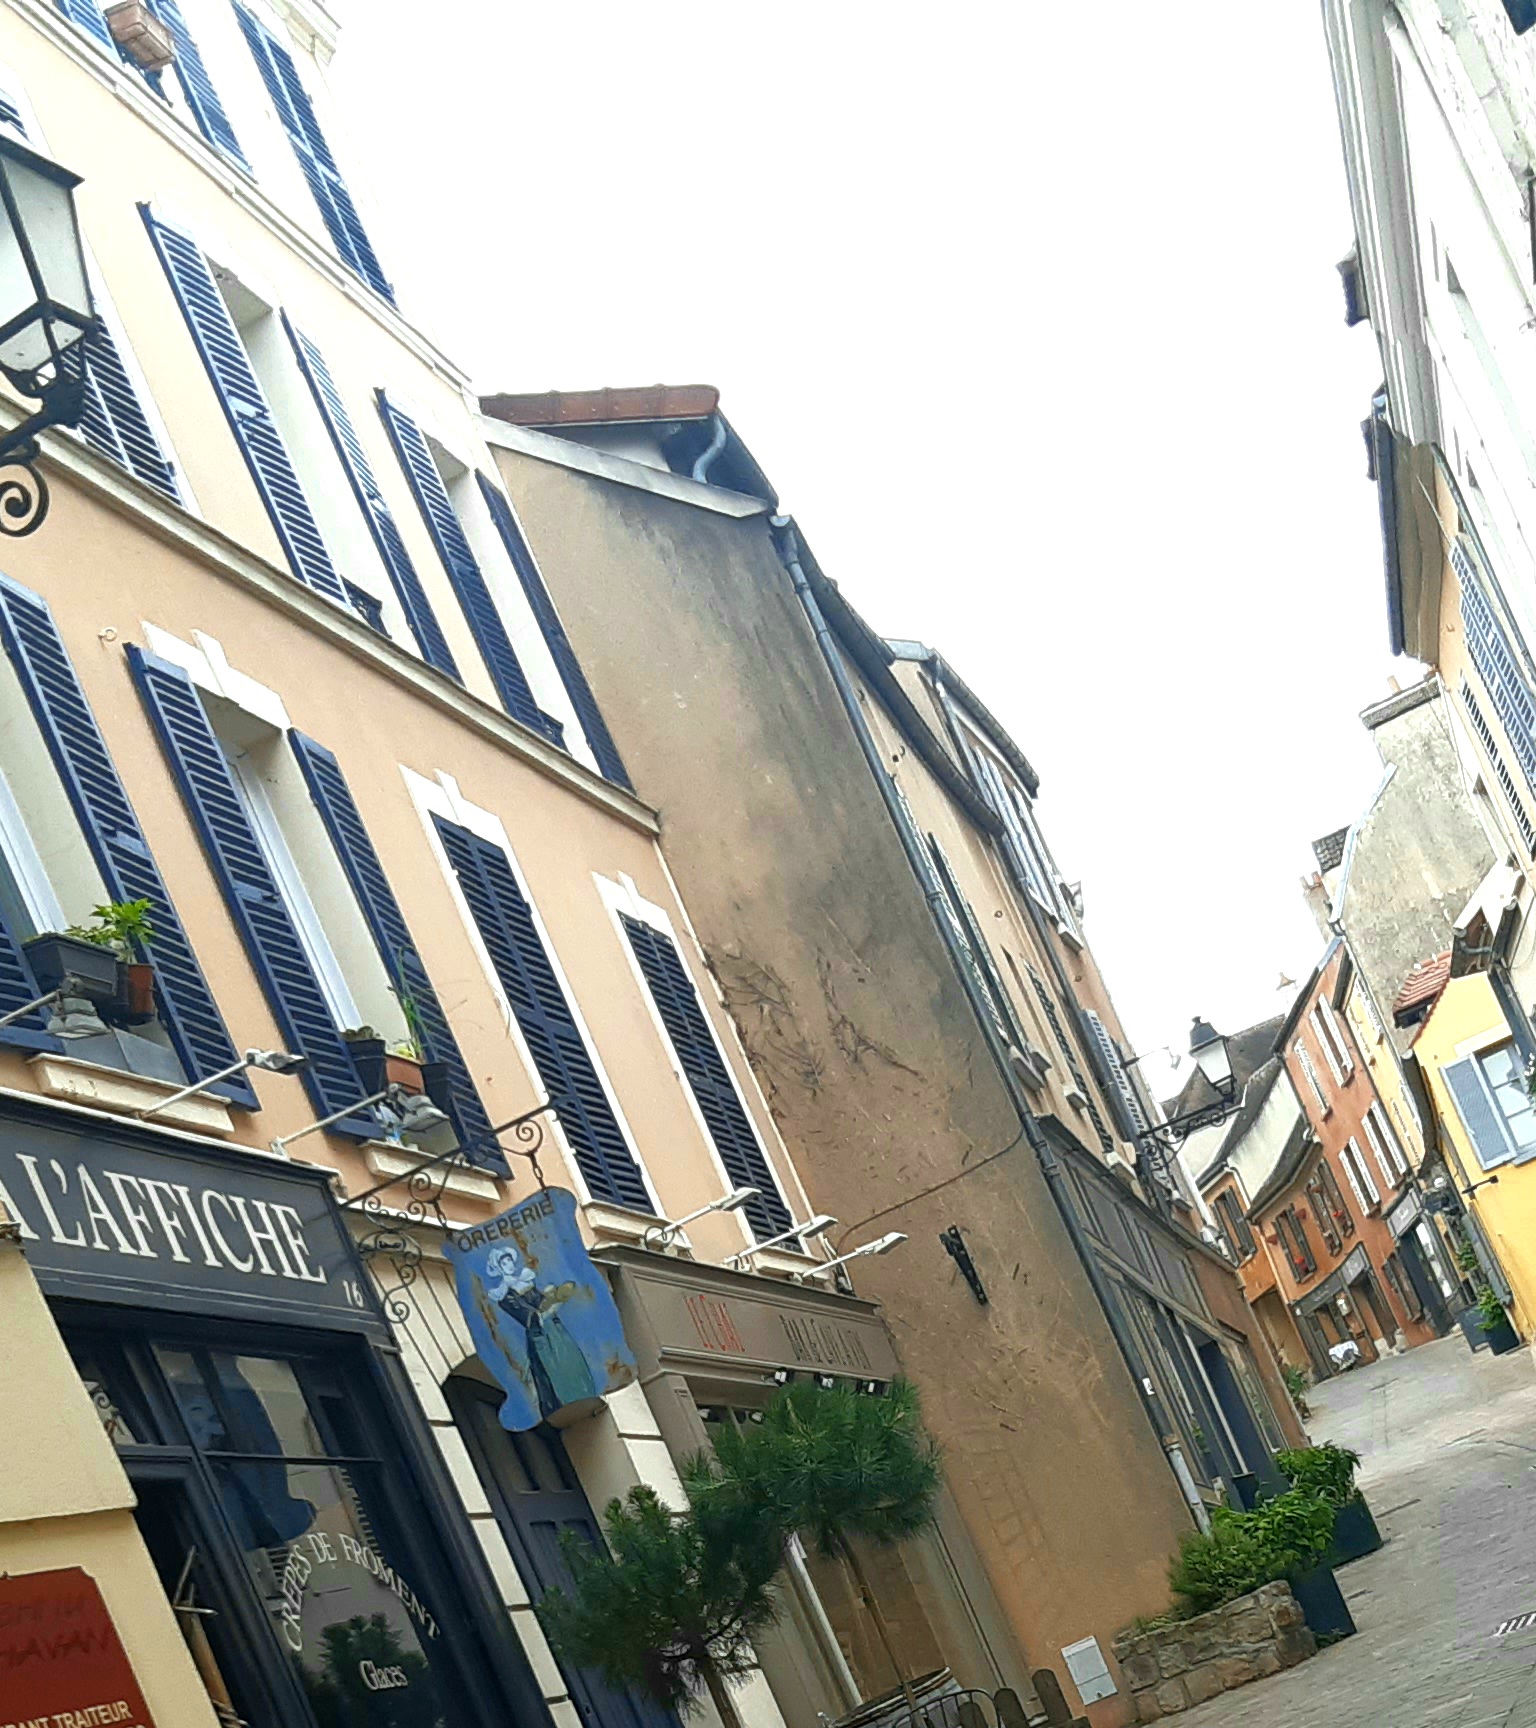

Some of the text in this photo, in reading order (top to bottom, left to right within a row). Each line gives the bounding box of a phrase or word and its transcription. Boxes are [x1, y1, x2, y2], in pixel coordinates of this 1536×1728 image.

[15, 1152, 328, 1285] L'AFFICHE
[342, 1279, 364, 1308] 16
[307, 1531, 338, 1565] DE
[338, 1532, 441, 1640] FROMENT
[359, 1659, 409, 1691] Glaces
